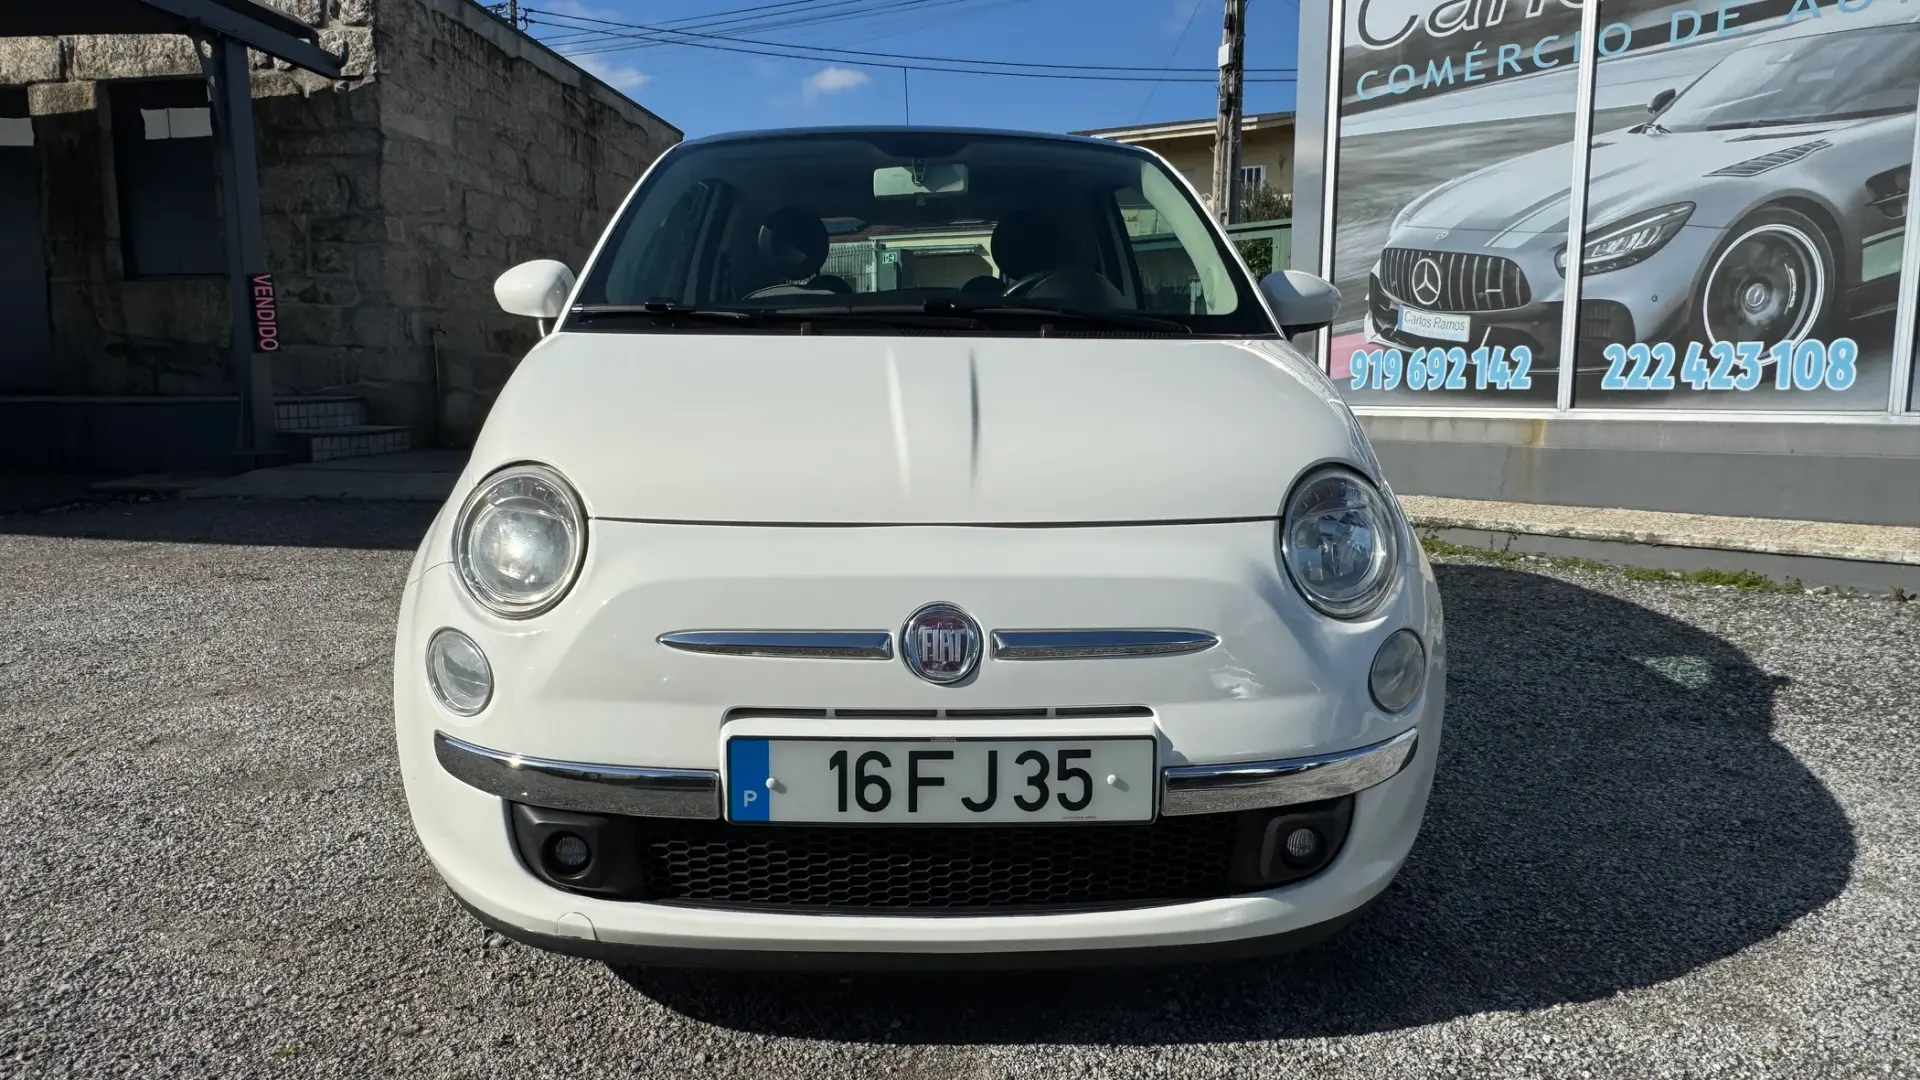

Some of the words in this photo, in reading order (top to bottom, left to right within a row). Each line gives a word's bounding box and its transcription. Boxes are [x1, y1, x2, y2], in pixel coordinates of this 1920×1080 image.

[1356, 22, 1632, 100] COMÉRCIO
[1669, 10, 1741, 47] DE
[253, 274, 279, 351] VENDIDO
[1404, 310, 1432, 330] Carlos
[1433, 316, 1466, 332] Ramos
[1350, 348, 1403, 391] 919
[1406, 346, 1467, 391] 692
[1471, 345, 1532, 390] 142
[1601, 342, 1676, 390] 222
[1680, 341, 1763, 391] 423
[1770, 338, 1859, 391] 108
[922, 629, 961, 662] FIAT
[743, 790, 758, 808] P
